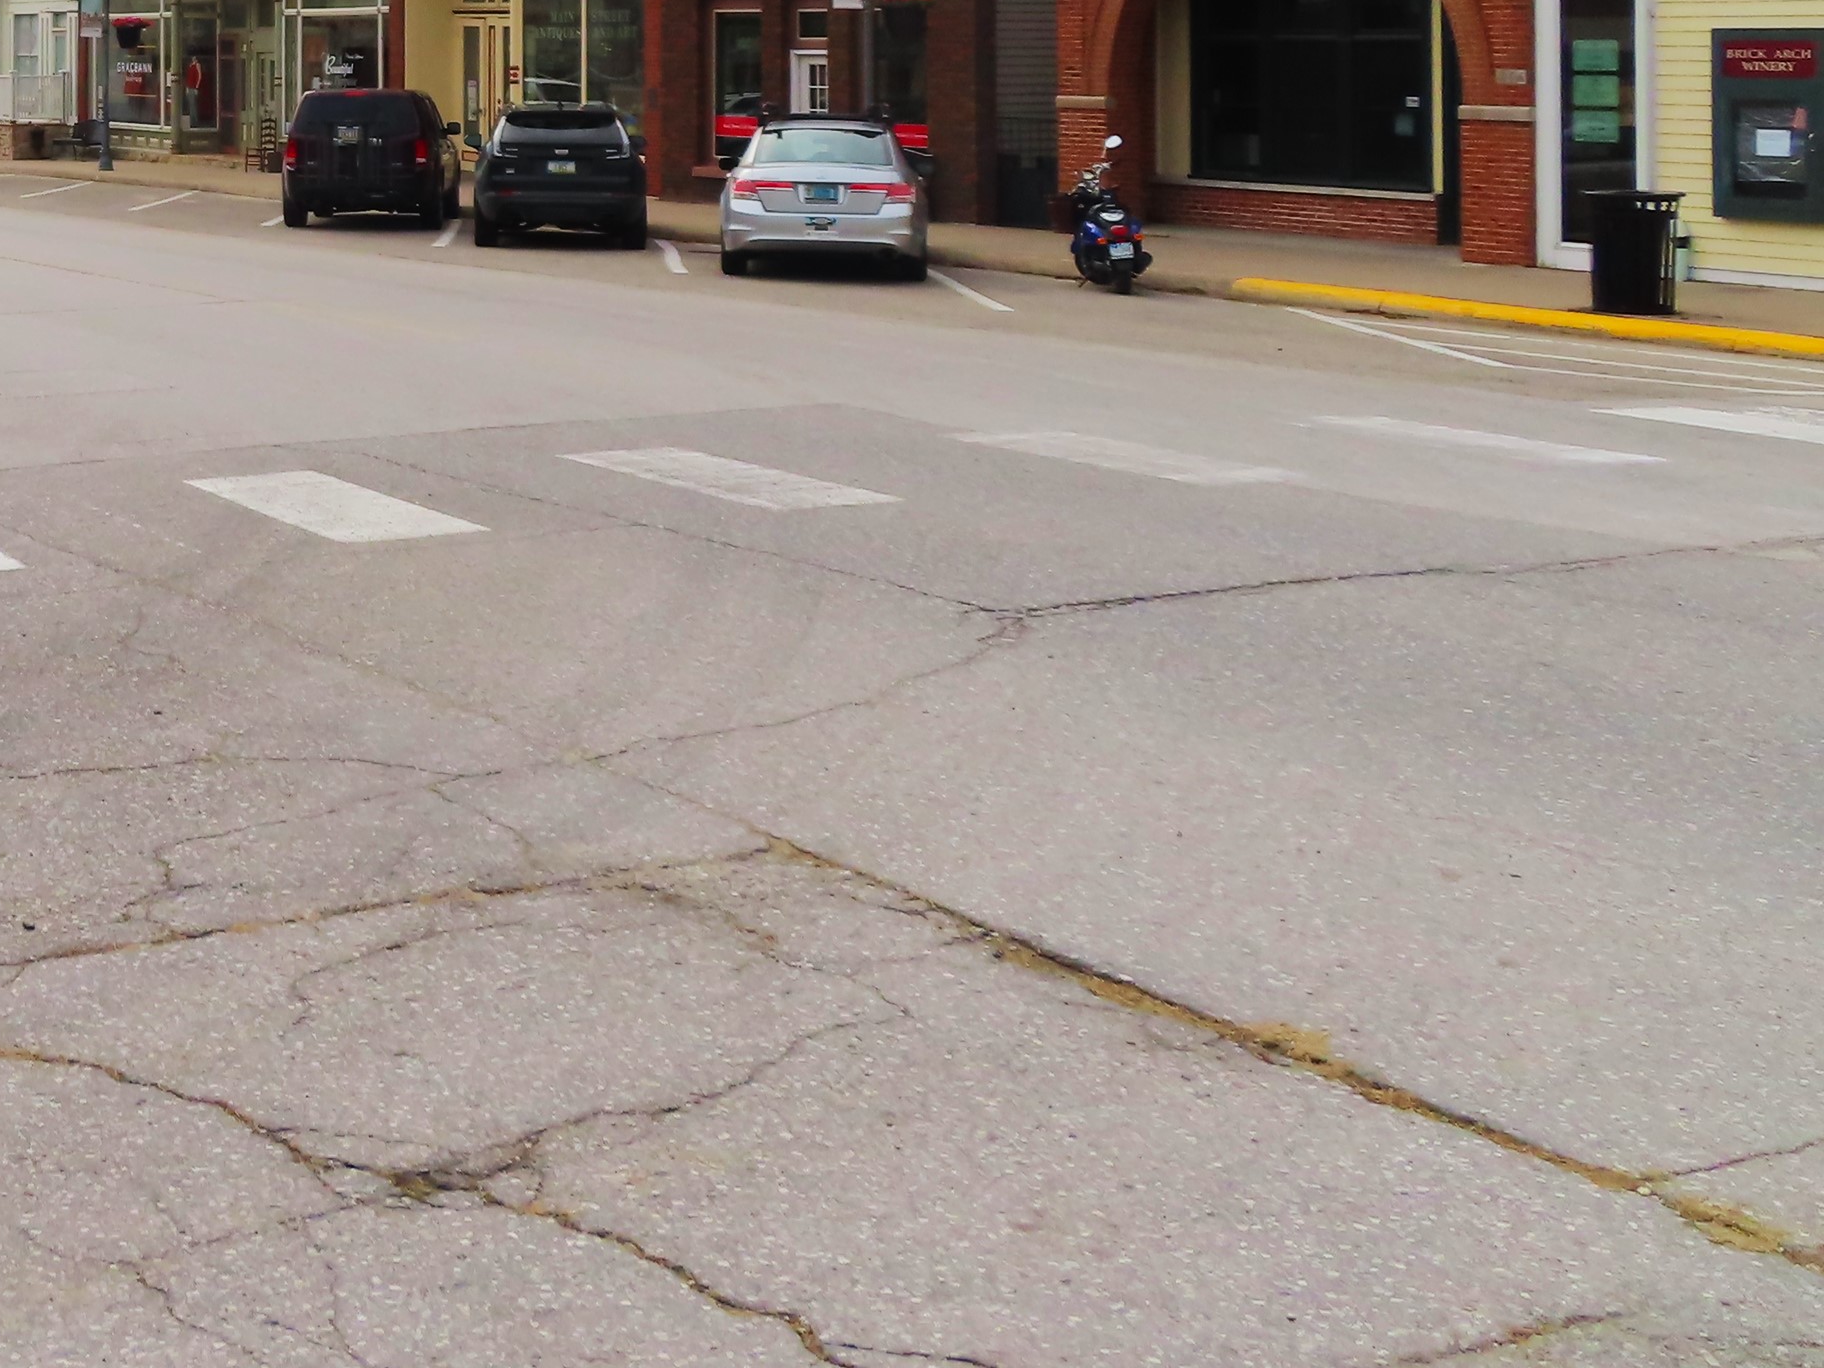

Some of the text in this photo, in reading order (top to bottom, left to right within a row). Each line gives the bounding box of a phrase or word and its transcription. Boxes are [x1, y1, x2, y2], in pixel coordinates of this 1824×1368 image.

[1726, 48, 1812, 59] BRICK ARCH
[1742, 61, 1796, 72] WINERY
